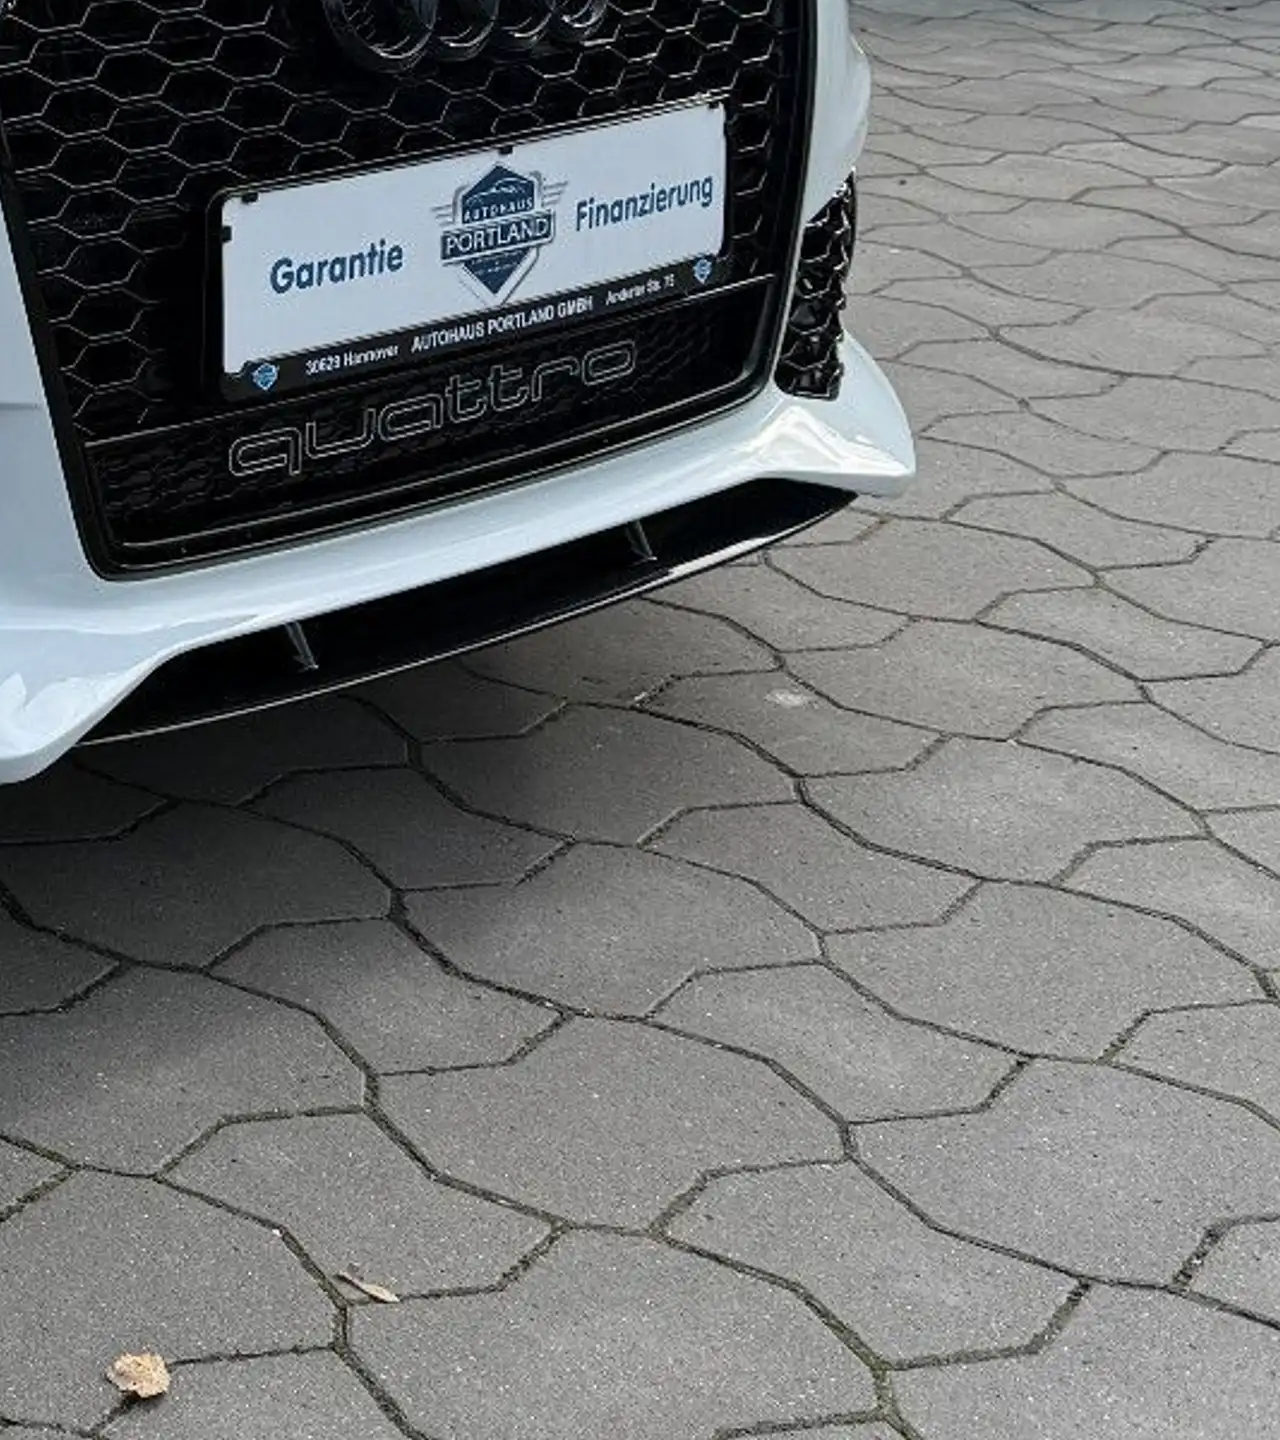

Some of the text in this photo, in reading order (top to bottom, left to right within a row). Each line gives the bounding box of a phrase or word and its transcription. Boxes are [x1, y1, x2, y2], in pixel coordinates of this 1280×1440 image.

[463, 197, 533, 222] AUTOHAUS
[575, 175, 714, 231] Finanzierung
[446, 216, 550, 256] PORTLAND
[269, 239, 403, 295] Garantie
[411, 320, 485, 354] AUTOHAUS
[487, 303, 554, 336] PORTLAND
[557, 295, 593, 319] GMBH
[228, 339, 637, 477] quattro
